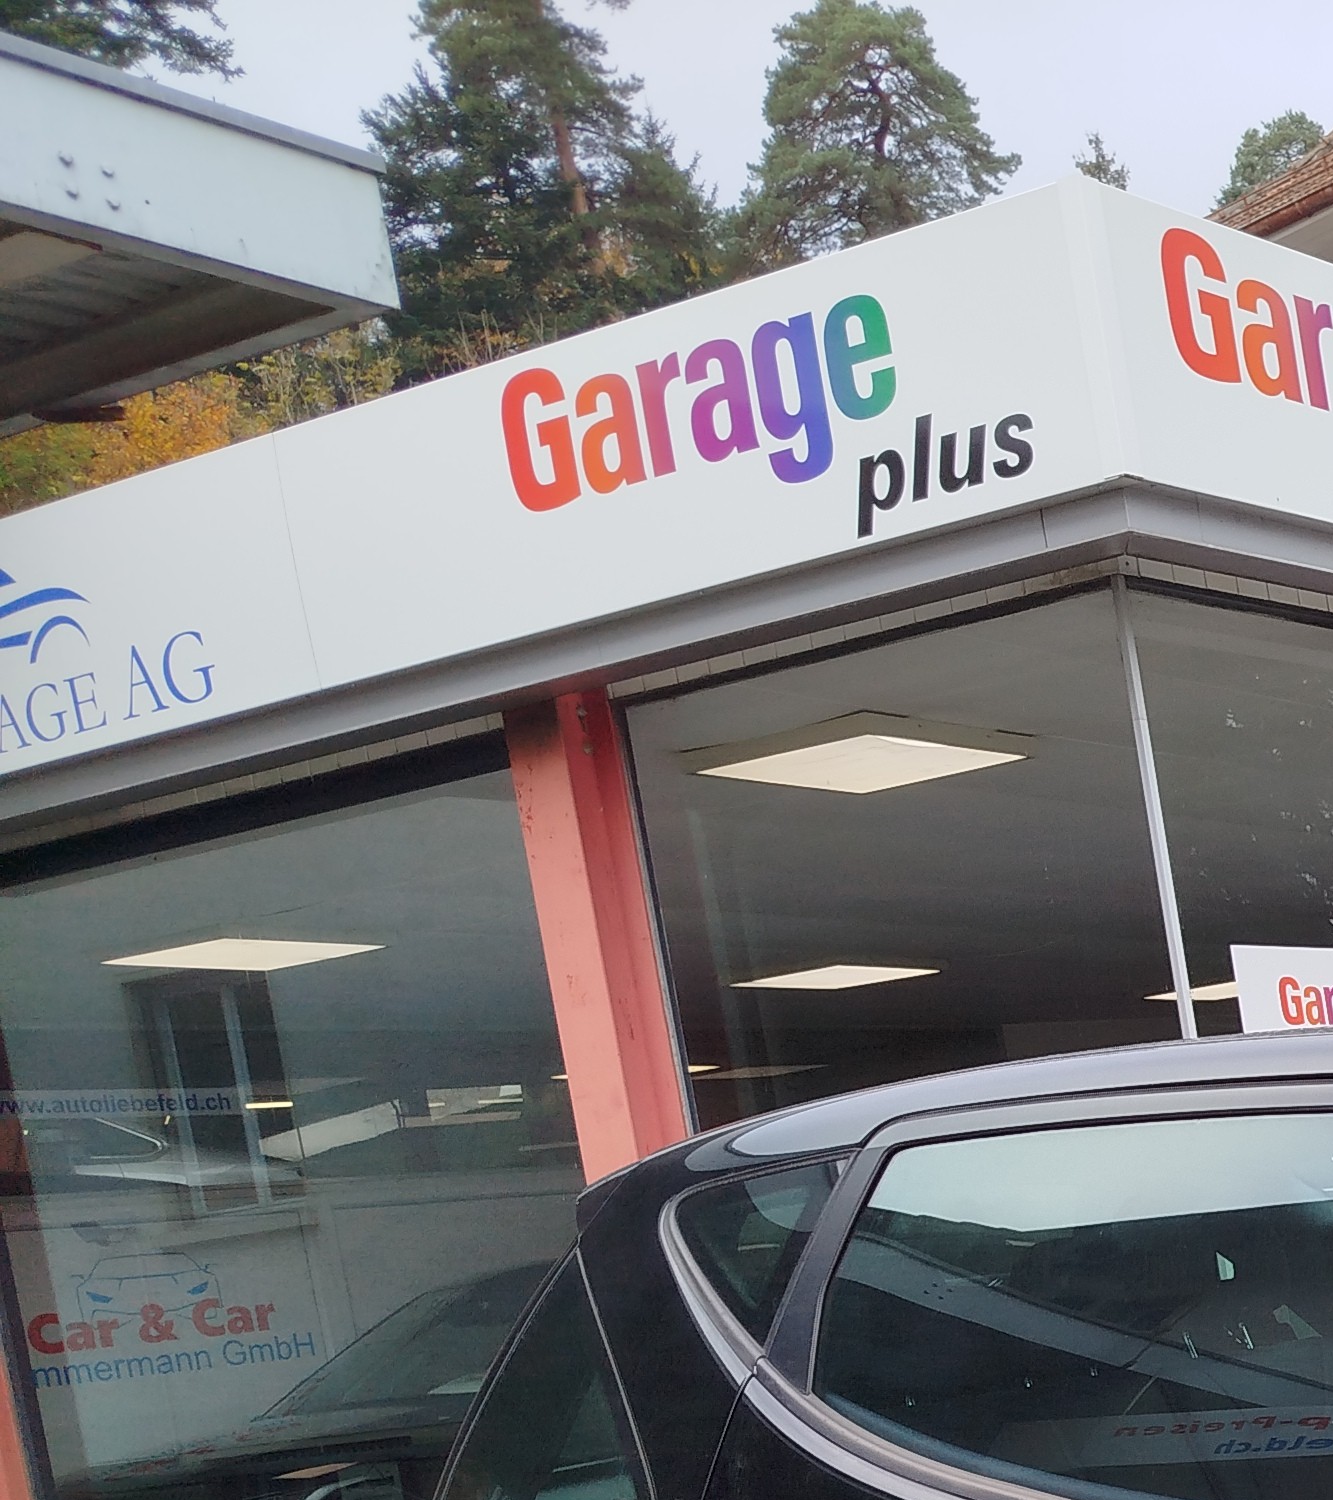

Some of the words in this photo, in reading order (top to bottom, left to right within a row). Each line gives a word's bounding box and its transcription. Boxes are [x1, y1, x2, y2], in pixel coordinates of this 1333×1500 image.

[501, 294, 897, 512] Garage
[857, 413, 1035, 539] plus
[123, 631, 215, 720] AG
[27, 1312, 119, 1355] Car
[138, 1303, 179, 1343] &
[191, 1297, 277, 1338] Car
[222, 1331, 317, 1366] GmbH
